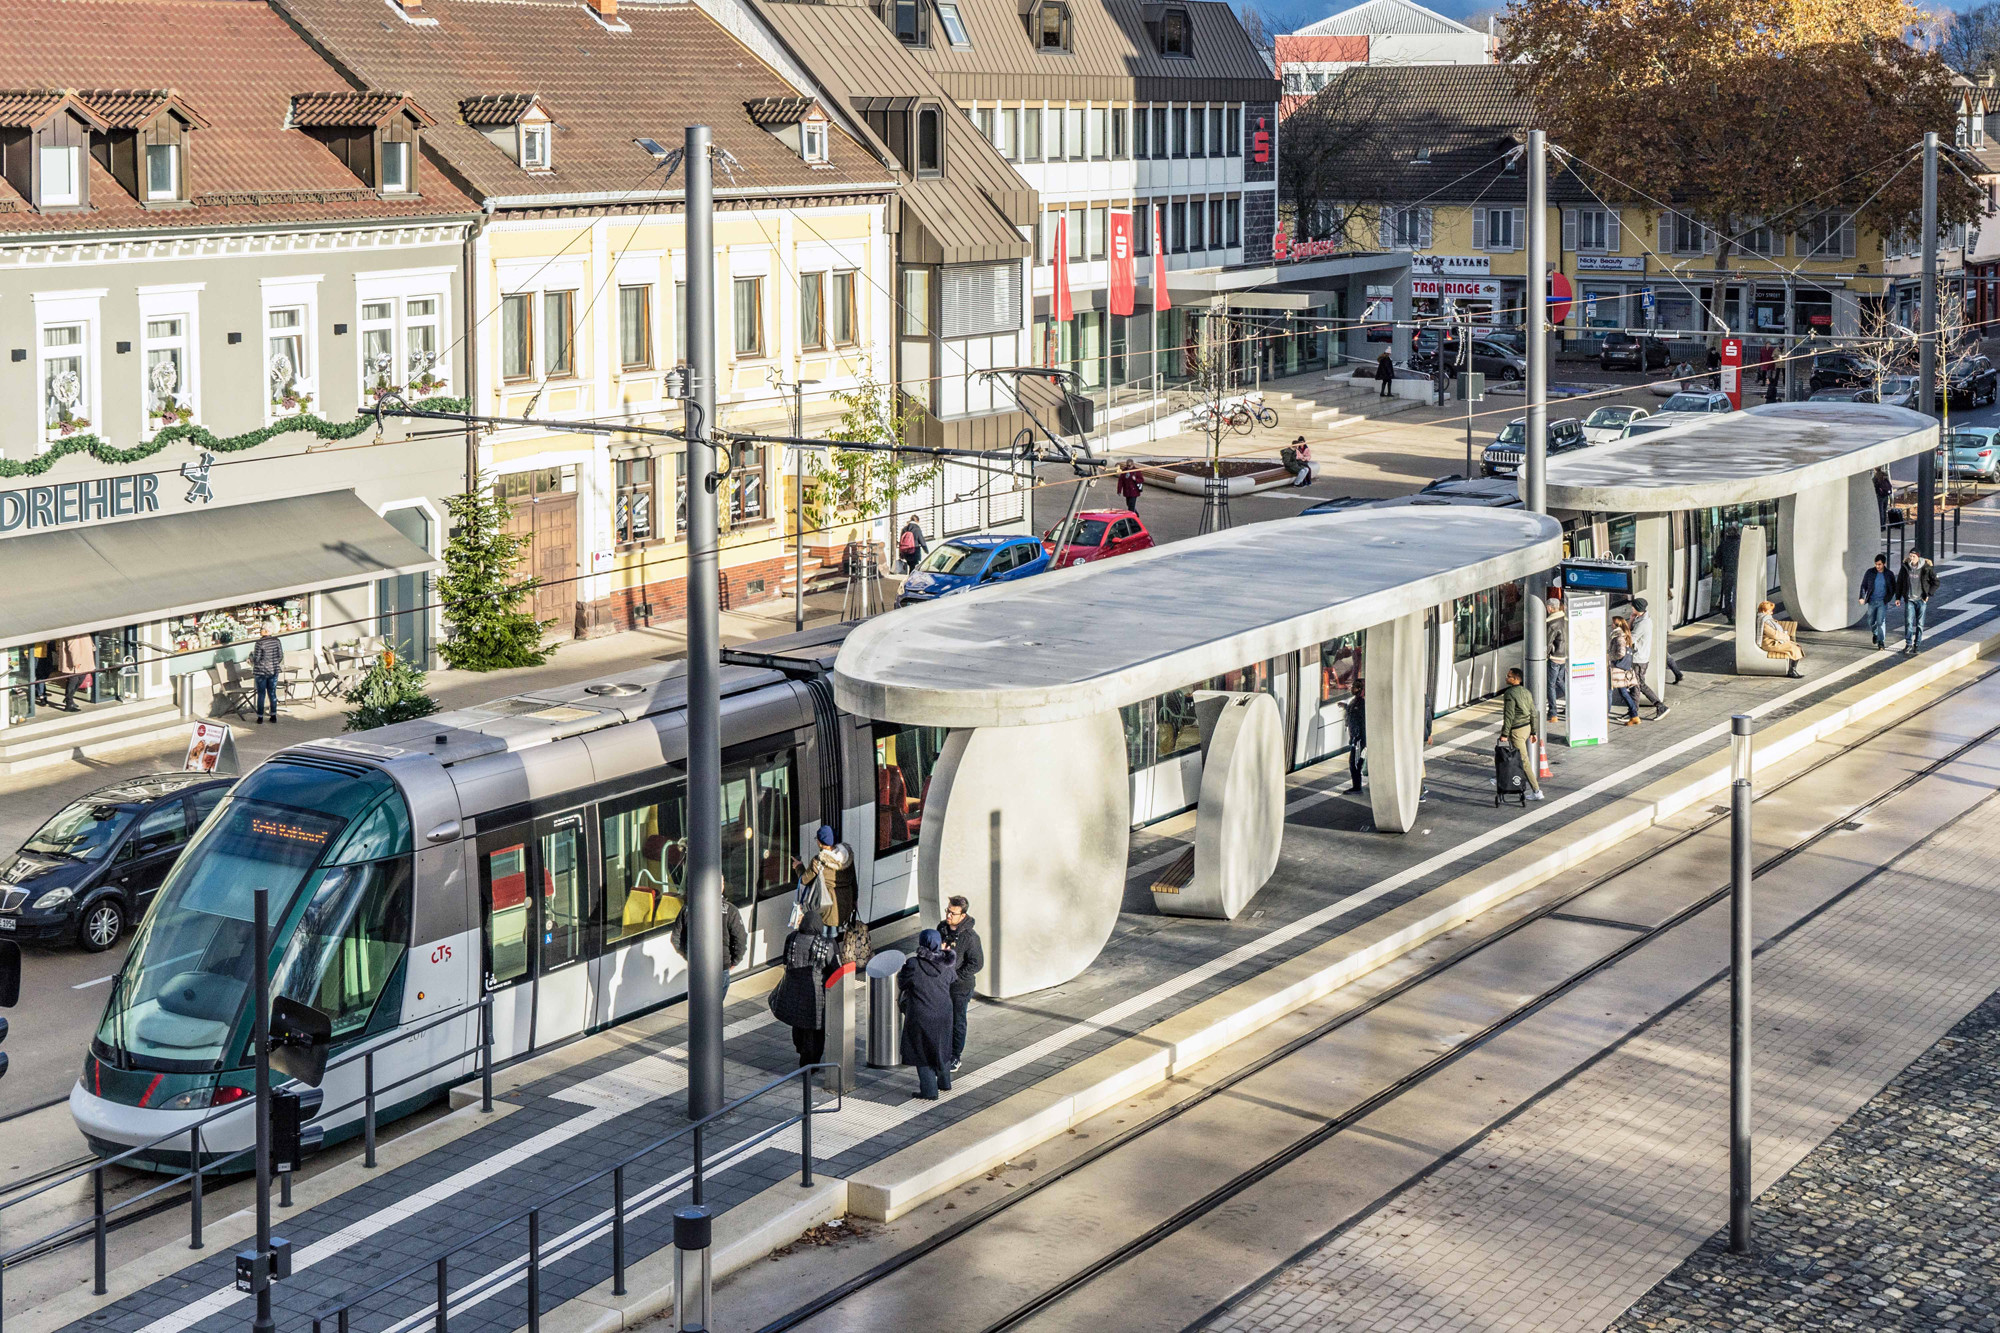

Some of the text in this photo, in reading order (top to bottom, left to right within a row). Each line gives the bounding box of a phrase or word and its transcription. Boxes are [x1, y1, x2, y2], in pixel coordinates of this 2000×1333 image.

[1288, 237, 1334, 262] Sparkasse
[1449, 258, 1489, 267] ALYANS
[1580, 258, 1598, 266] Nicky
[0, 474, 160, 532] DREHER
